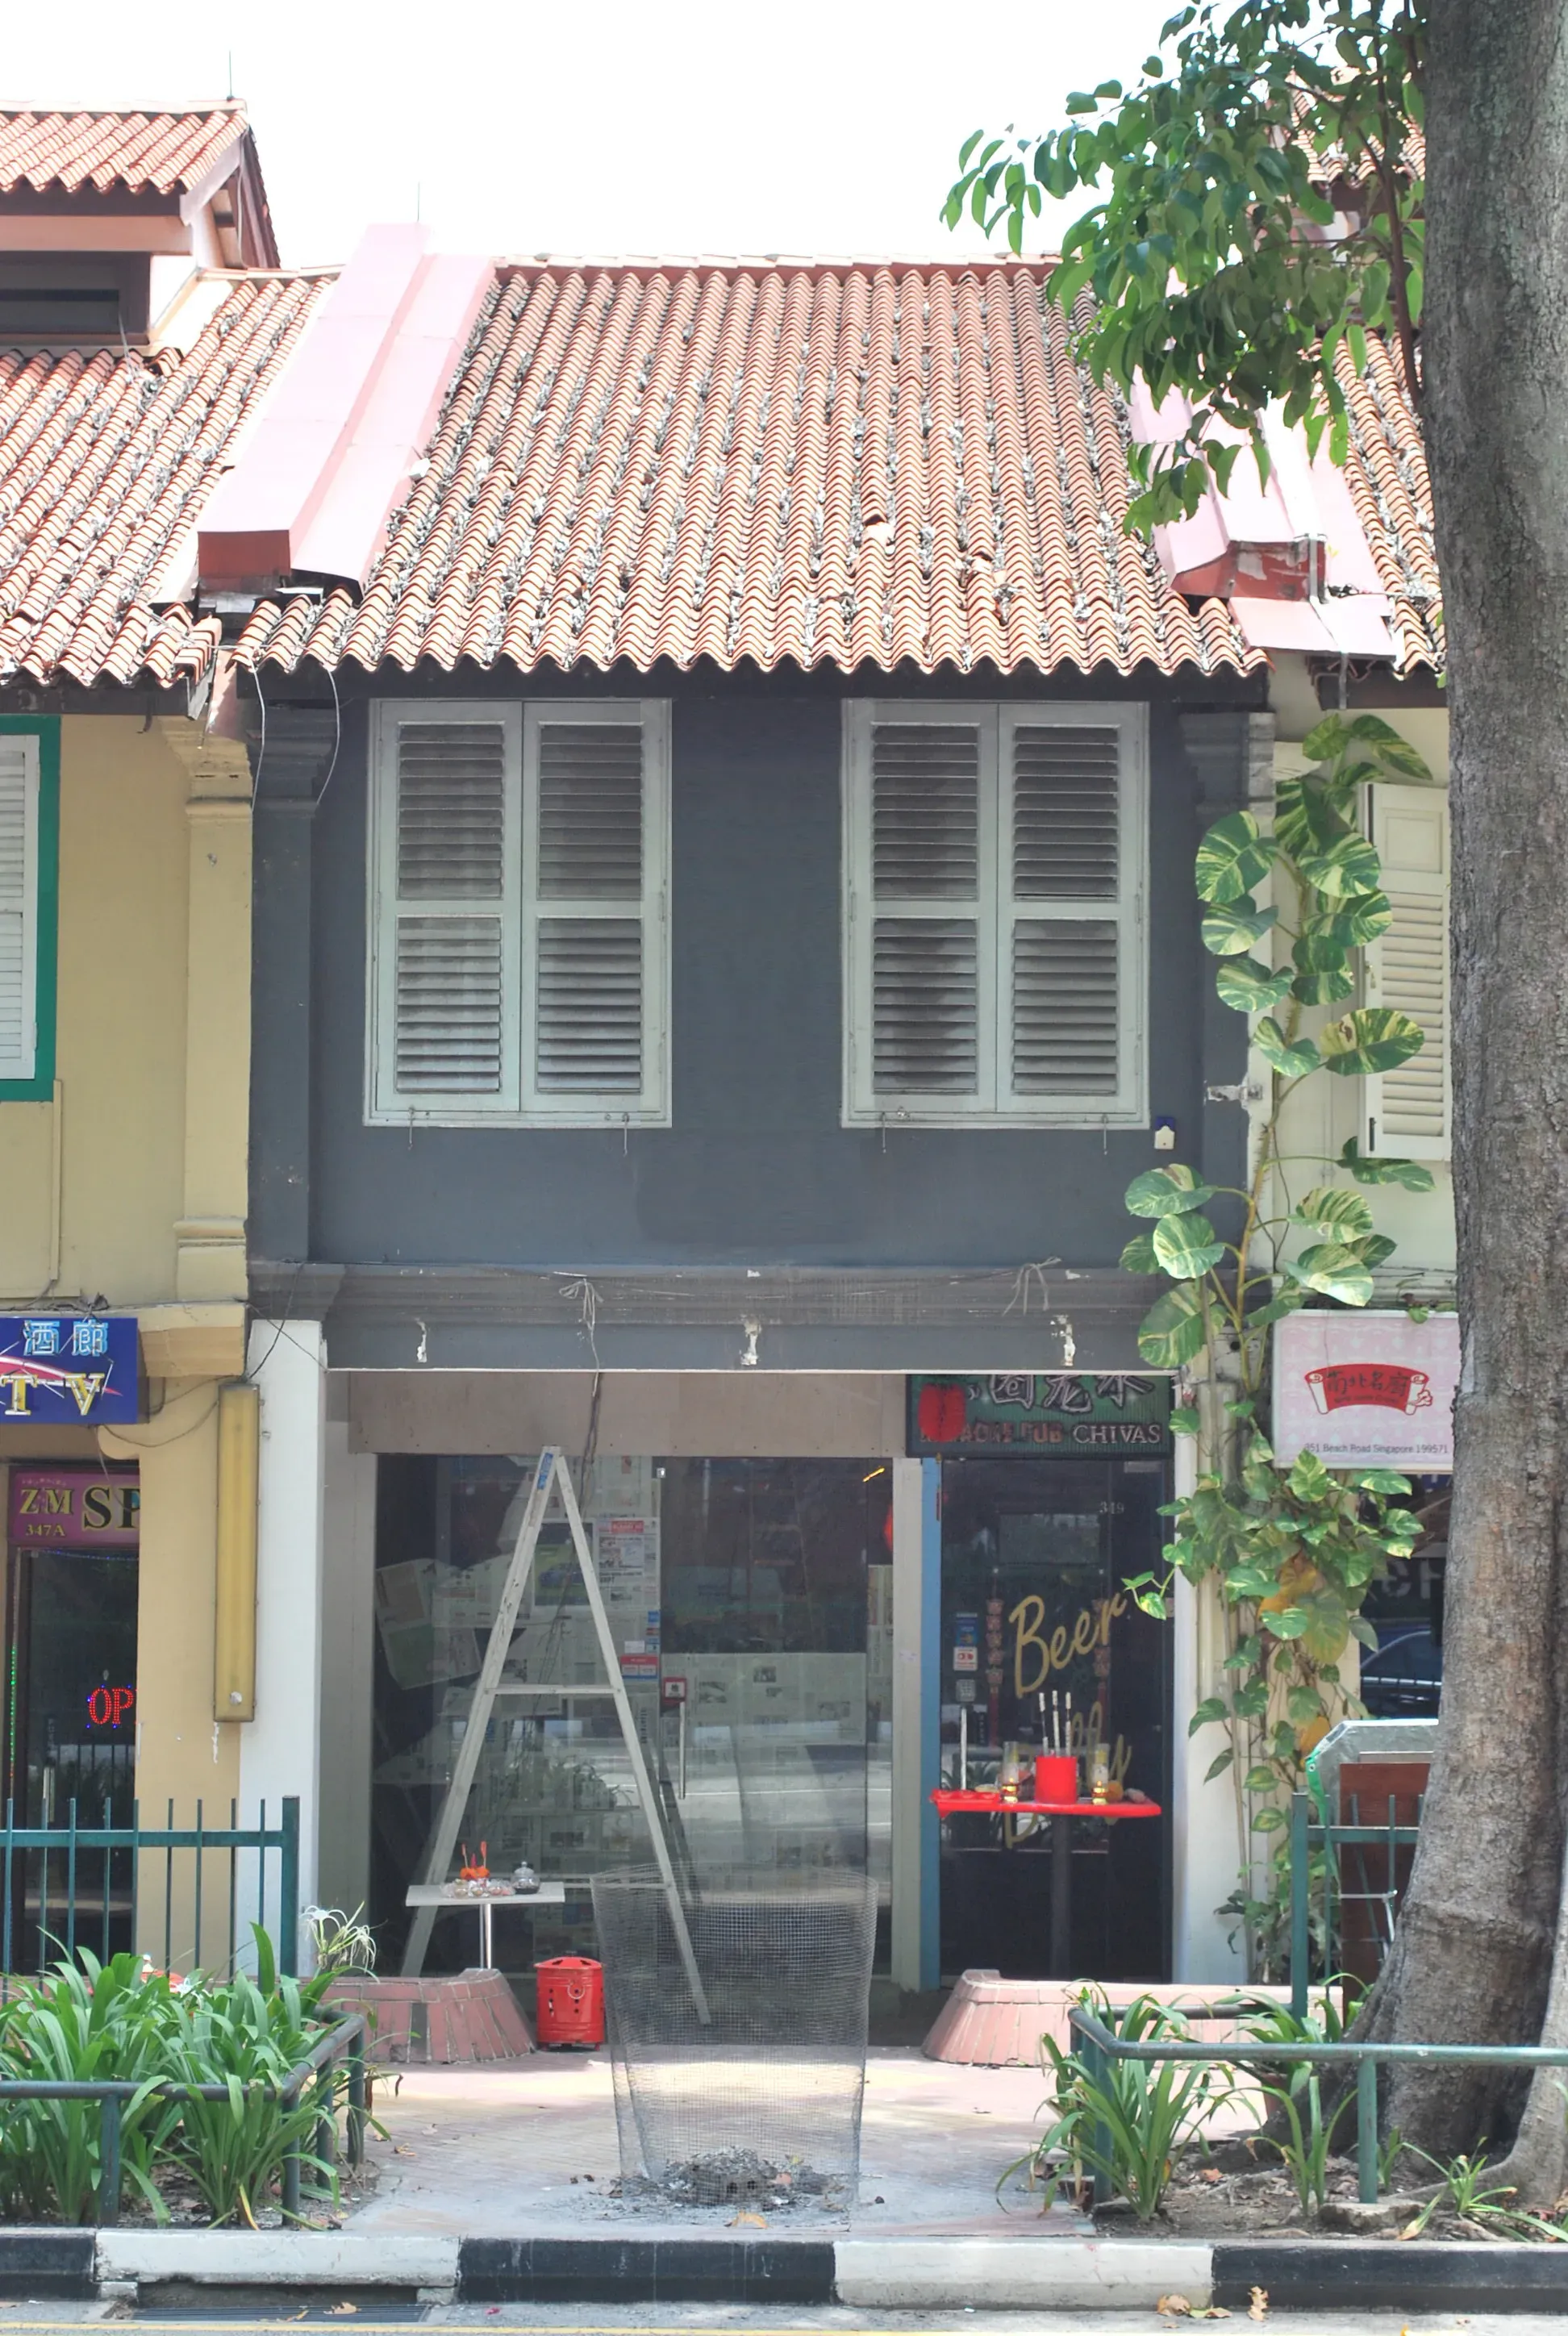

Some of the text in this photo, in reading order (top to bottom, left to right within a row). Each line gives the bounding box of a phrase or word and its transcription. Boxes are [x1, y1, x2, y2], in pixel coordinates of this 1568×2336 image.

[23, 1320, 108, 1357] 酒廊
[1073, 1424, 1162, 1445] CHIVAS
[1323, 1443, 1348, 1453] Beach
[1350, 1443, 1371, 1453] Road
[1374, 1442, 1414, 1454] Singapore
[19, 1487, 73, 1516] ZM
[25, 1524, 65, 1537] 347A
[1008, 1593, 1128, 1700] Beer
[89, 1687, 138, 1725] OP
